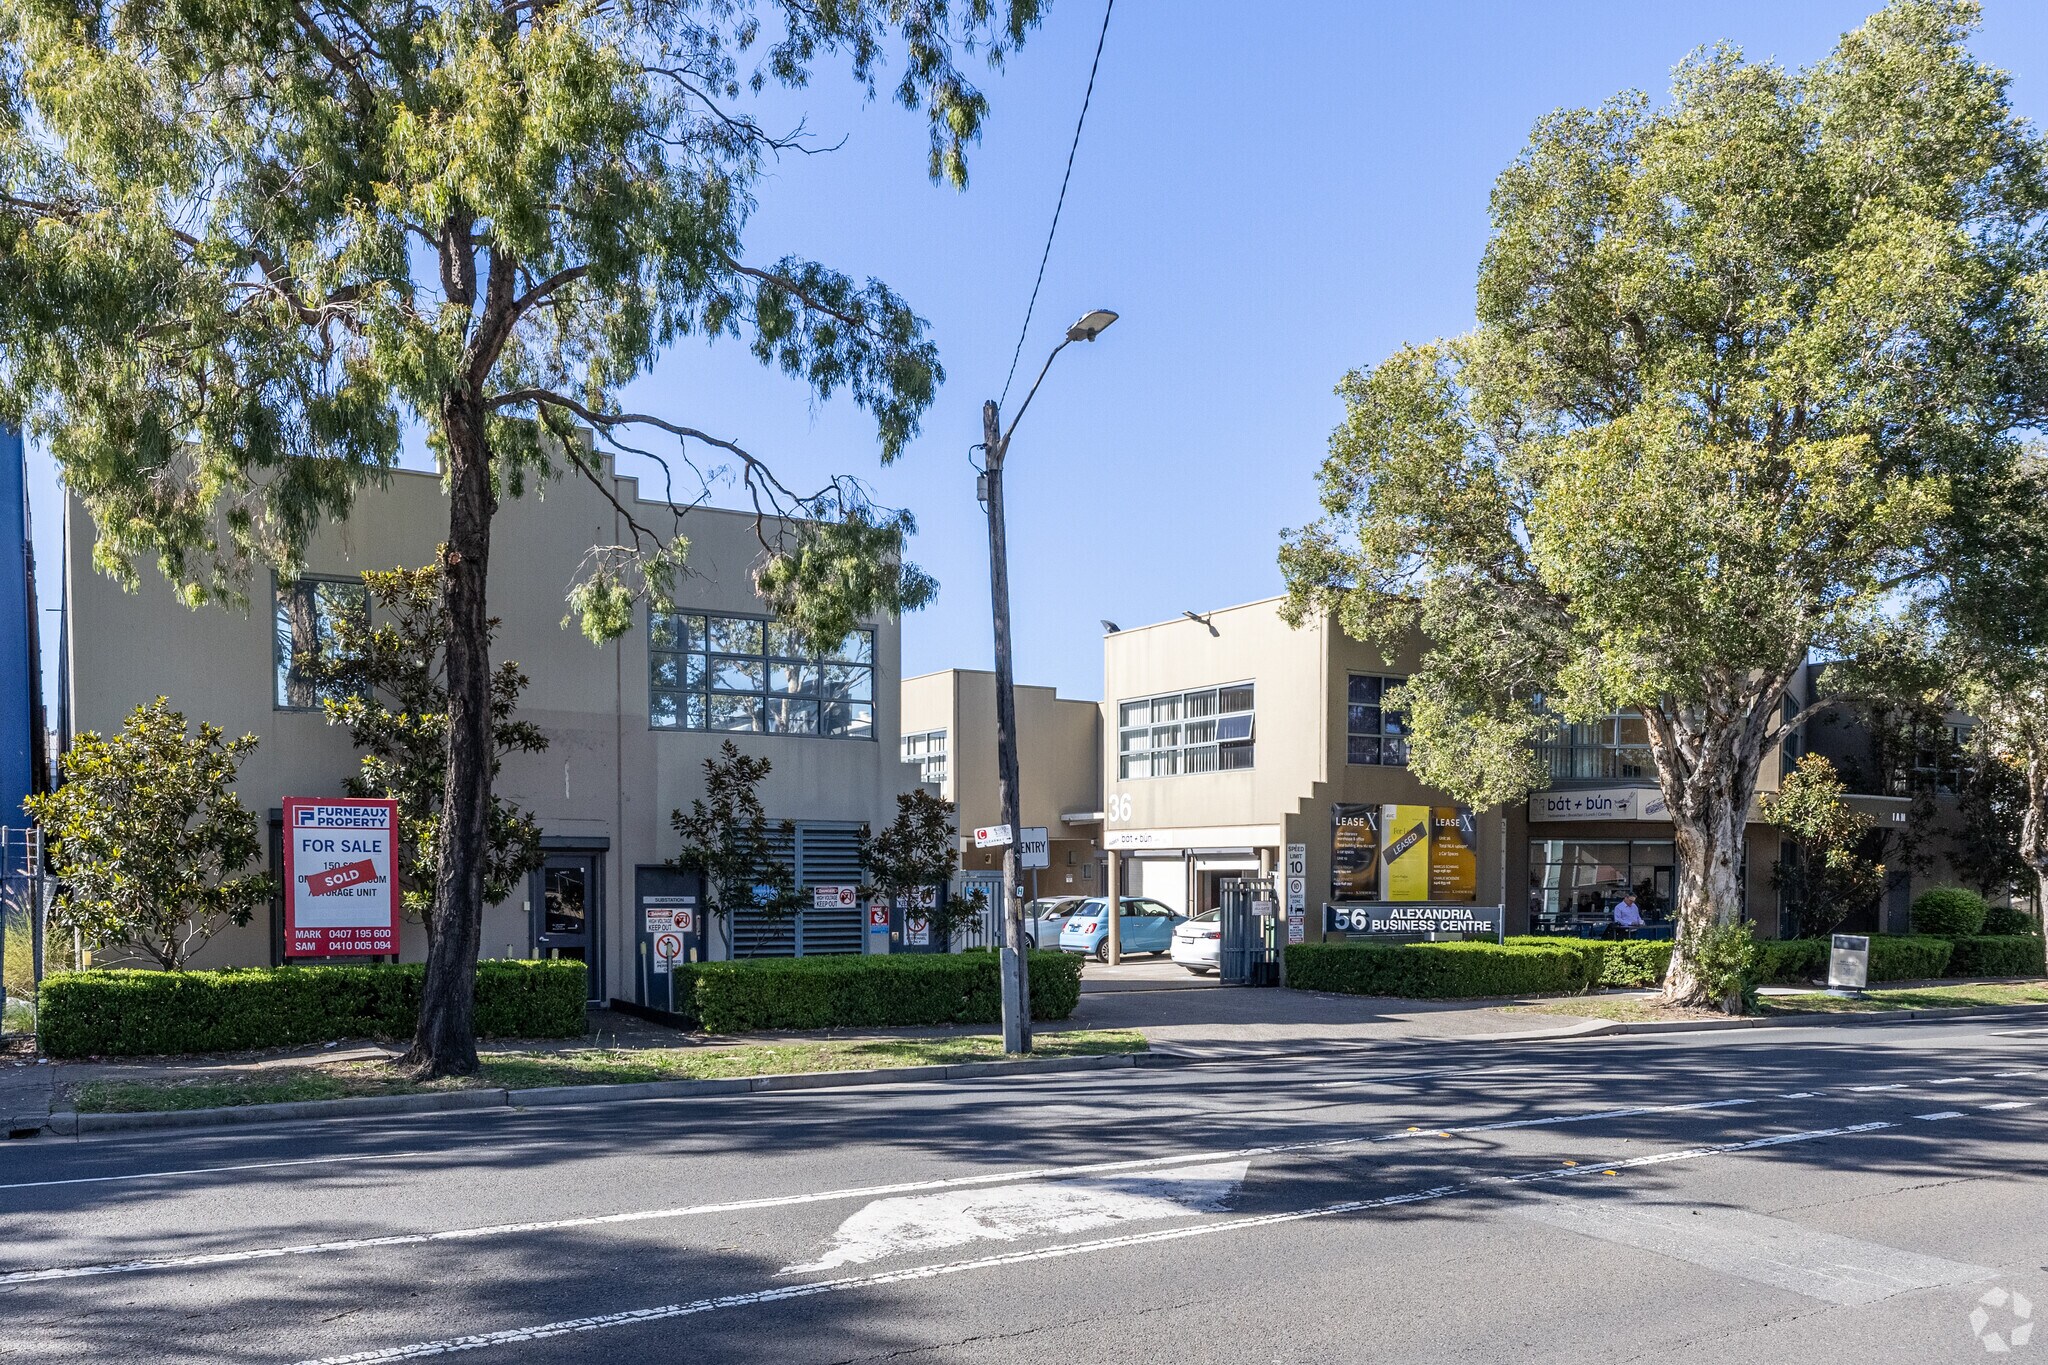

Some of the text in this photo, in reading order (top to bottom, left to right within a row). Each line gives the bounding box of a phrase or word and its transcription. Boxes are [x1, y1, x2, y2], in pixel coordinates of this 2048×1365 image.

[1109, 793, 1132, 822] 36
[1547, 794, 1612, 811] bát + bún
[317, 807, 388, 817] FURNEAUX
[317, 817, 386, 827] PROPERTY
[1335, 812, 1378, 831] LEASE X
[1435, 814, 1473, 832] LEASE X
[978, 829, 986, 840] C
[302, 839, 382, 853] FOR SALE
[1021, 841, 1046, 854] ENTRY
[1393, 832, 1417, 855] LEASED
[324, 861, 340, 870] 150
[1289, 861, 1303, 873] 10
[325, 869, 359, 886] SOLD
[321, 888, 353, 897] ORAGE
[356, 888, 377, 897] UNIT
[1335, 909, 1367, 930] 56
[1390, 909, 1473, 919] ALEXANDRIA
[1372, 920, 1491, 931] BUSINESS CENTRE
[295, 929, 391, 939] MARK 0407 195 600
[295, 941, 391, 951] SAM 0410 005 094
